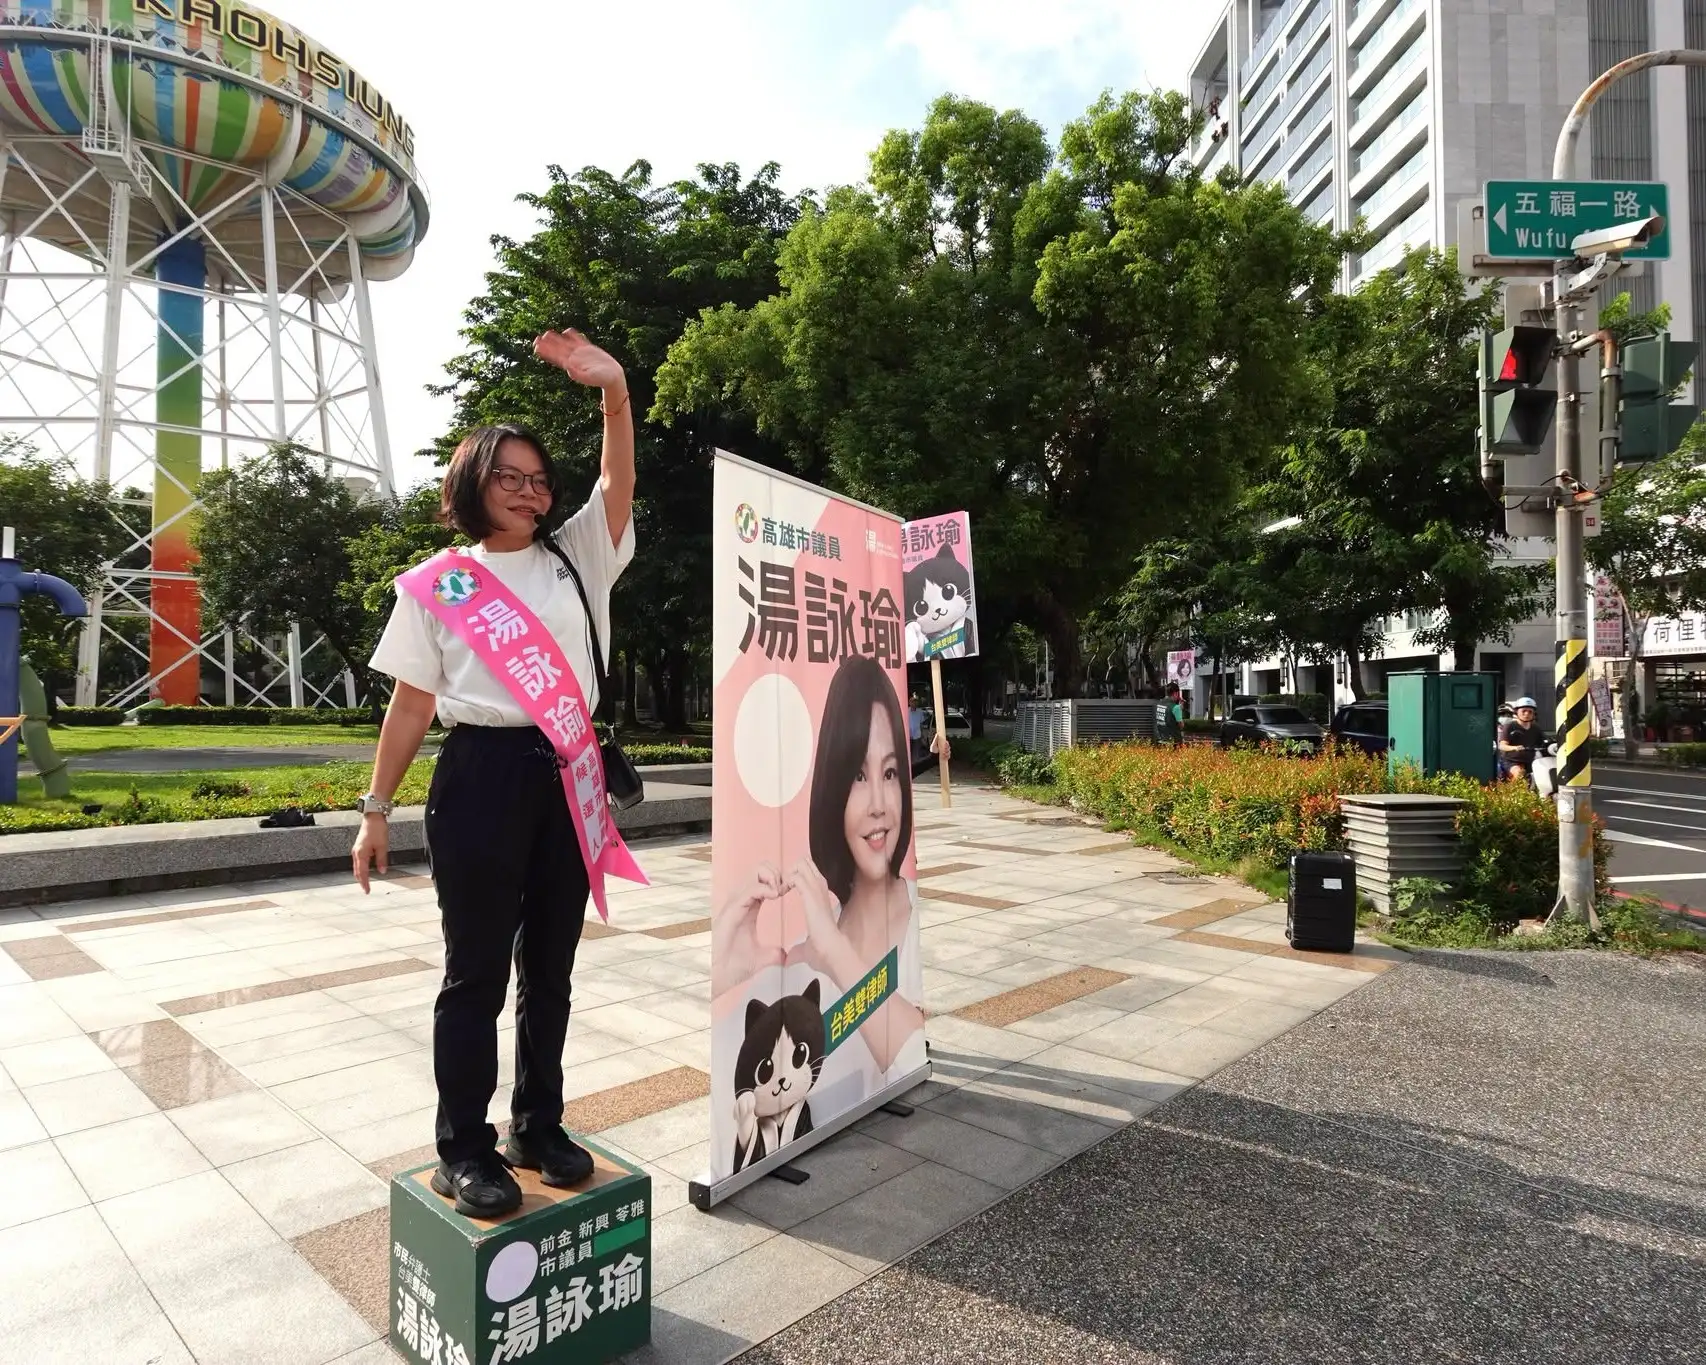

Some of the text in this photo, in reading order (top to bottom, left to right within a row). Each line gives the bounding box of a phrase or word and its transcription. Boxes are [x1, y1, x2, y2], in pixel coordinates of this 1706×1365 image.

[1515, 190, 1641, 218] 五福一路
[1515, 228, 1567, 249] Wufu
[761, 517, 842, 562] 高雄市議員
[738, 555, 902, 669] 湯詠瑜
[467, 598, 587, 748] 湯詠瑜
[576, 761, 600, 857] 候選人
[831, 964, 888, 1043] 台美雙律師
[540, 1199, 645, 1256] 前金 新興 苓雅
[540, 1240, 593, 1277] 市議員
[487, 1252, 645, 1365] 湯詠瑜
